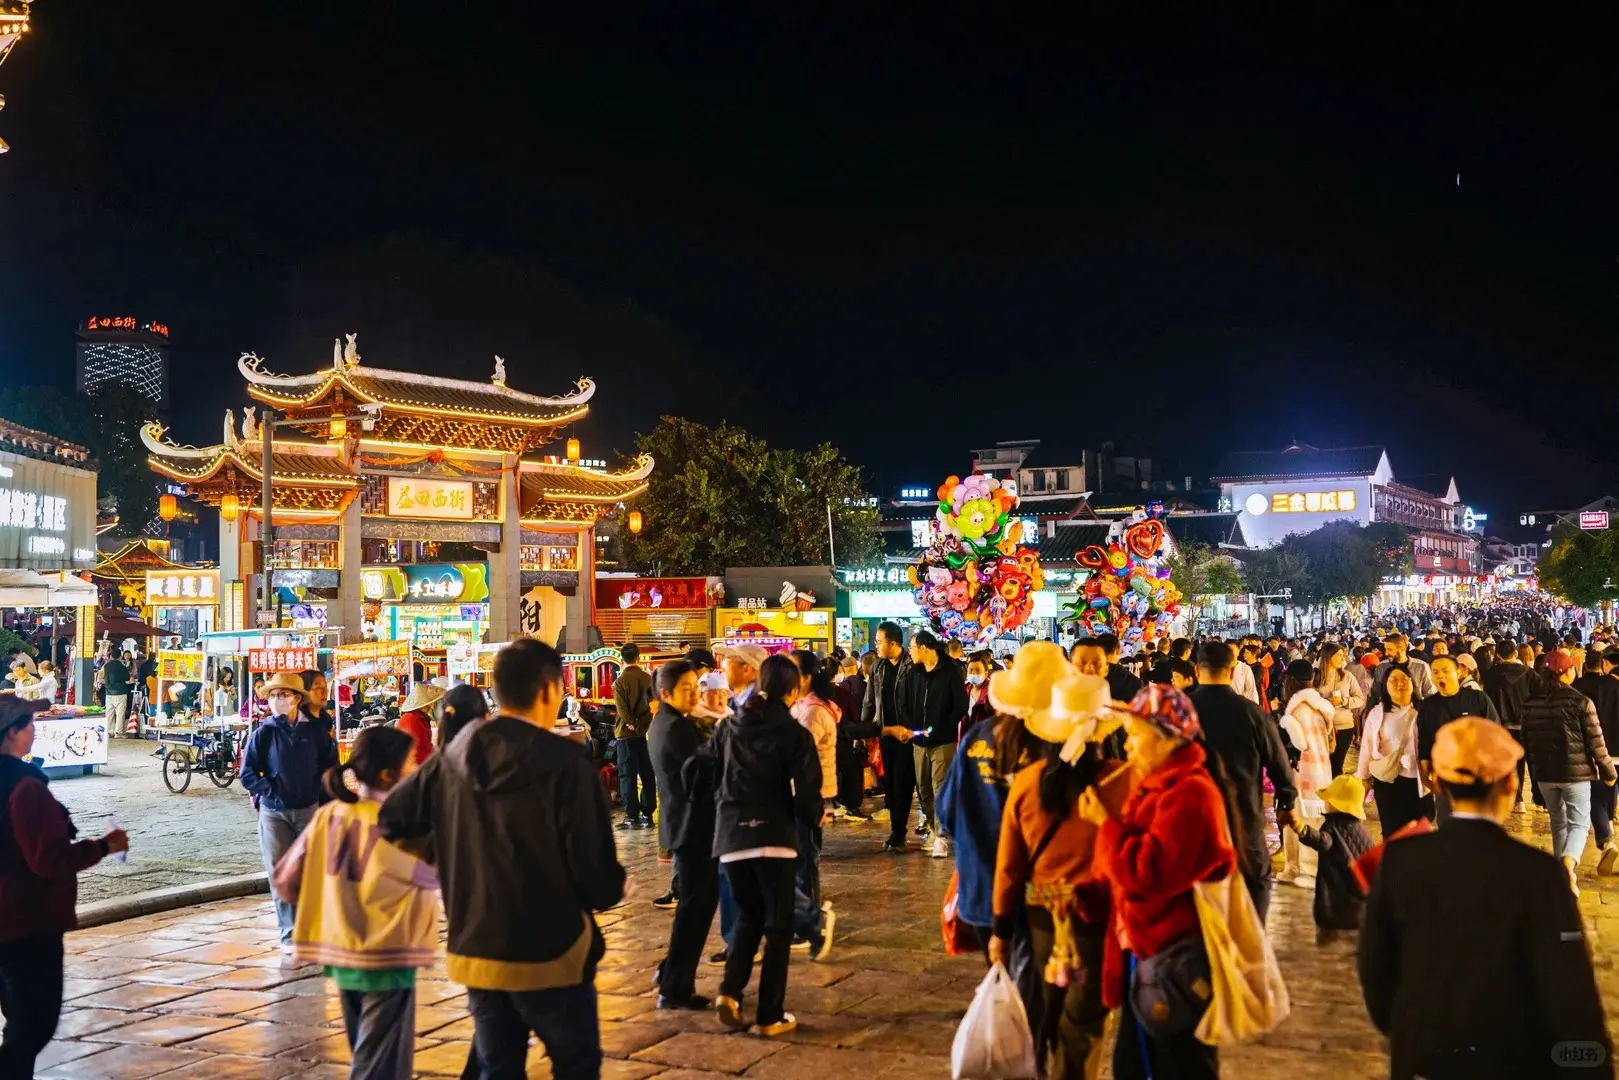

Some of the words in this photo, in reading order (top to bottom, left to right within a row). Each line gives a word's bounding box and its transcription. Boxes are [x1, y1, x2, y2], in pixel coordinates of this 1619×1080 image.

[396, 485, 466, 512] 益田西街
[738, 597, 767, 609] 甜品站
[250, 651, 314, 670] 阳朔特色糯米饭
